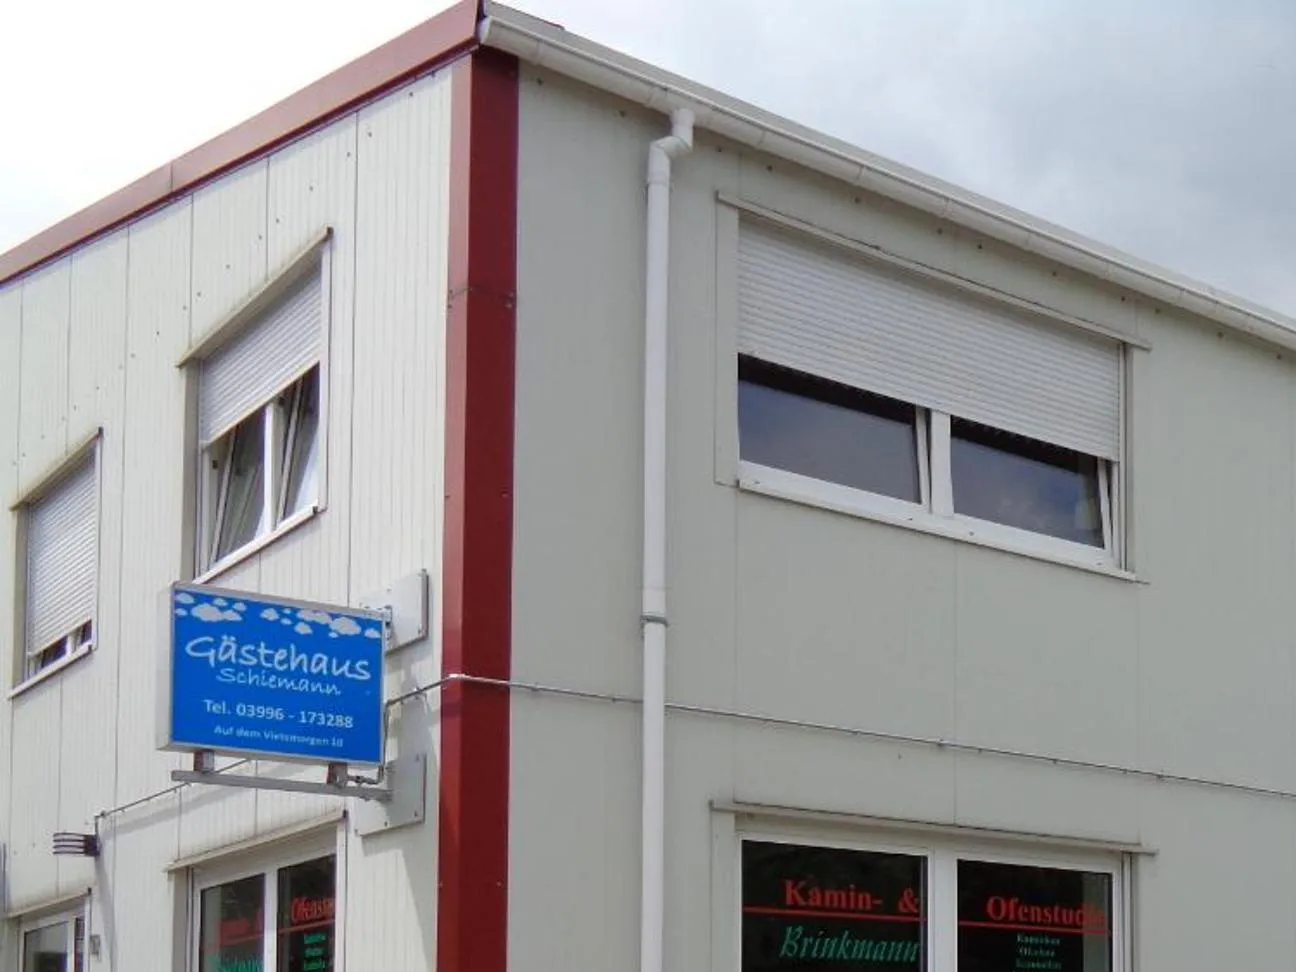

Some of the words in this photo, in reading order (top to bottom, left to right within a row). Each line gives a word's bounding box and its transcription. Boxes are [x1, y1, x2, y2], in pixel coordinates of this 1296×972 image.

[185, 634, 371, 680] Gästehaus
[216, 667, 341, 696] Schiemann
[203, 699, 231, 715] Tel.
[236, 702, 284, 720] 03996
[299, 710, 353, 728] 173288
[213, 725, 234, 736] Auf
[236, 726, 261, 738] dem
[784, 879, 883, 910] Kamin-
[898, 887, 920, 913] &
[779, 925, 920, 962] Brinkmann
